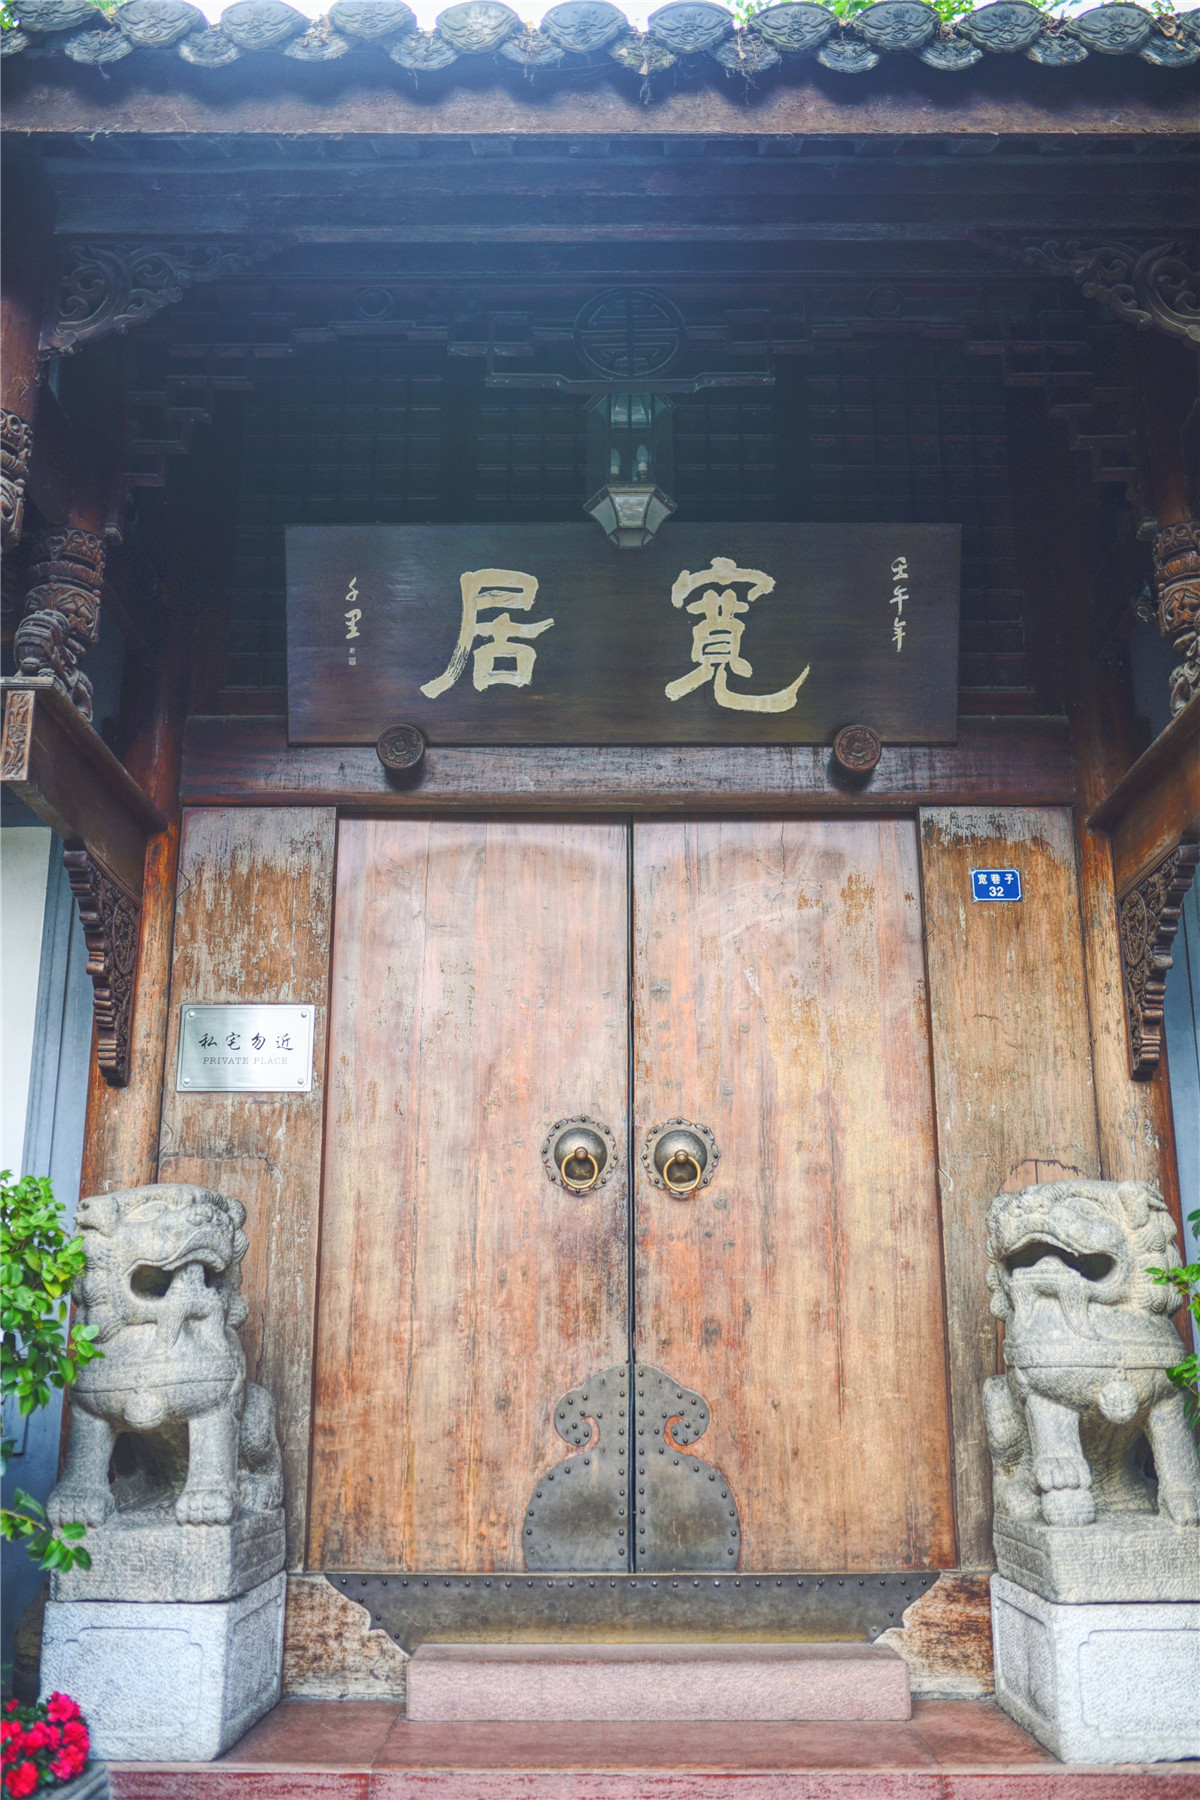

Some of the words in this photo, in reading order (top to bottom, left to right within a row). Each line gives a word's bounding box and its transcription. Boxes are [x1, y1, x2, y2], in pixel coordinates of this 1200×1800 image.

[977, 873, 1014, 885] 宽巷子
[988, 886, 1005, 897] 32
[198, 1032, 294, 1051] 私宅勿近
[202, 1056, 249, 1065] PRIVATE
[253, 1056, 288, 1065] PLACE
